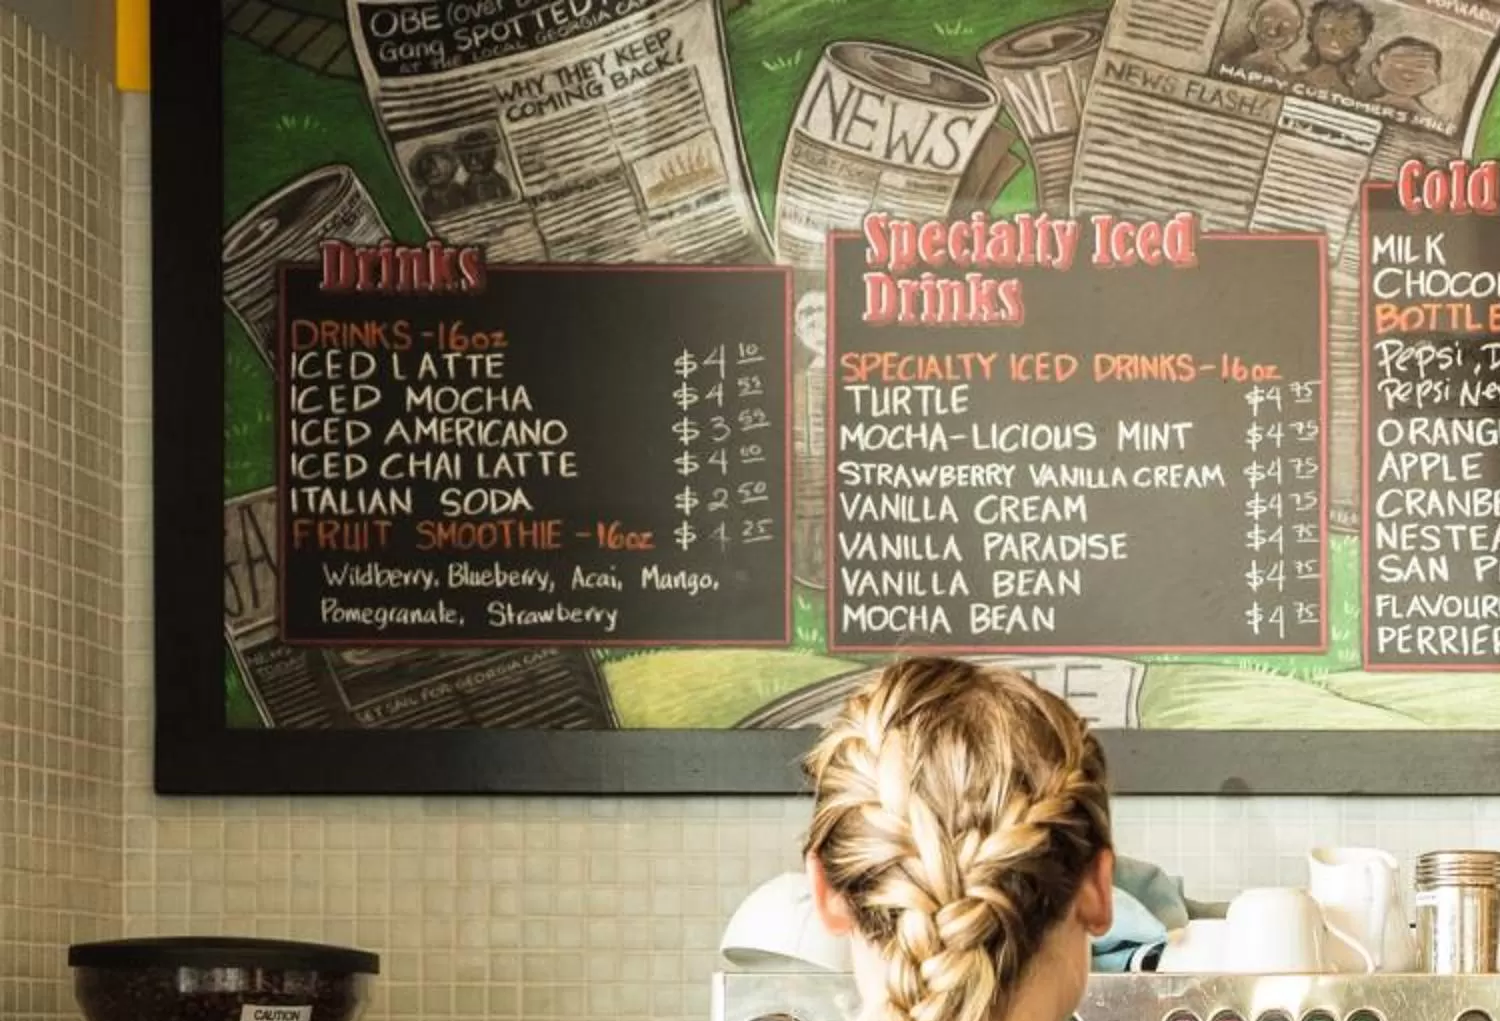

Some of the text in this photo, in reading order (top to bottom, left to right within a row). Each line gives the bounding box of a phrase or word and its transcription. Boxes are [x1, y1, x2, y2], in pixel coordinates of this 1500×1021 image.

[370, 3, 444, 39] OBE
[379, 40, 445, 64] Gang
[499, 27, 672, 104] WHY THEY KEEP
[504, 39, 684, 122] COMING BACK!
[1104, 59, 1177, 94] NEWS
[1218, 63, 1290, 92] HAPPY
[1293, 83, 1408, 124] CUSTOMERS
[801, 67, 977, 170] NEWS
[1399, 160, 1500, 213] Cold
[863, 212, 1200, 270] Specialty Iced
[1373, 233, 1446, 265] MILK
[319, 238, 484, 292] Drinks
[862, 272, 1024, 325] Drinks
[292, 320, 413, 352] DRINKS
[291, 351, 505, 382] ICED LATTE
[841, 353, 1077, 383] SPECIALTY ICED
[291, 385, 534, 414] ICED MOCHA
[844, 385, 969, 417] TURTLE
[1378, 375, 1453, 412] Pepsi
[291, 418, 569, 447] ICED AMERICANO
[840, 422, 1097, 452] MOCHA-LICIOUS
[1118, 421, 1193, 452] MINT
[291, 451, 579, 481] ICED CHAI LATTE
[838, 462, 1016, 489] STRAWBERRY
[1031, 465, 1127, 489] VANILLA
[1132, 465, 1225, 489] CREAM
[1378, 452, 1482, 482] APPLE
[291, 488, 534, 516] ITALIAN SODA
[840, 494, 1087, 524] VANILLA CREAM
[294, 520, 393, 551] FRUIT
[416, 520, 562, 551] SMOOTHIE
[839, 532, 1128, 561] VANILLA PARADISE
[842, 568, 1081, 597] VANILLA BEAN
[1378, 555, 1449, 584] SAN
[488, 599, 618, 632] Strawberry
[842, 605, 1055, 634] MOCHA BEAN
